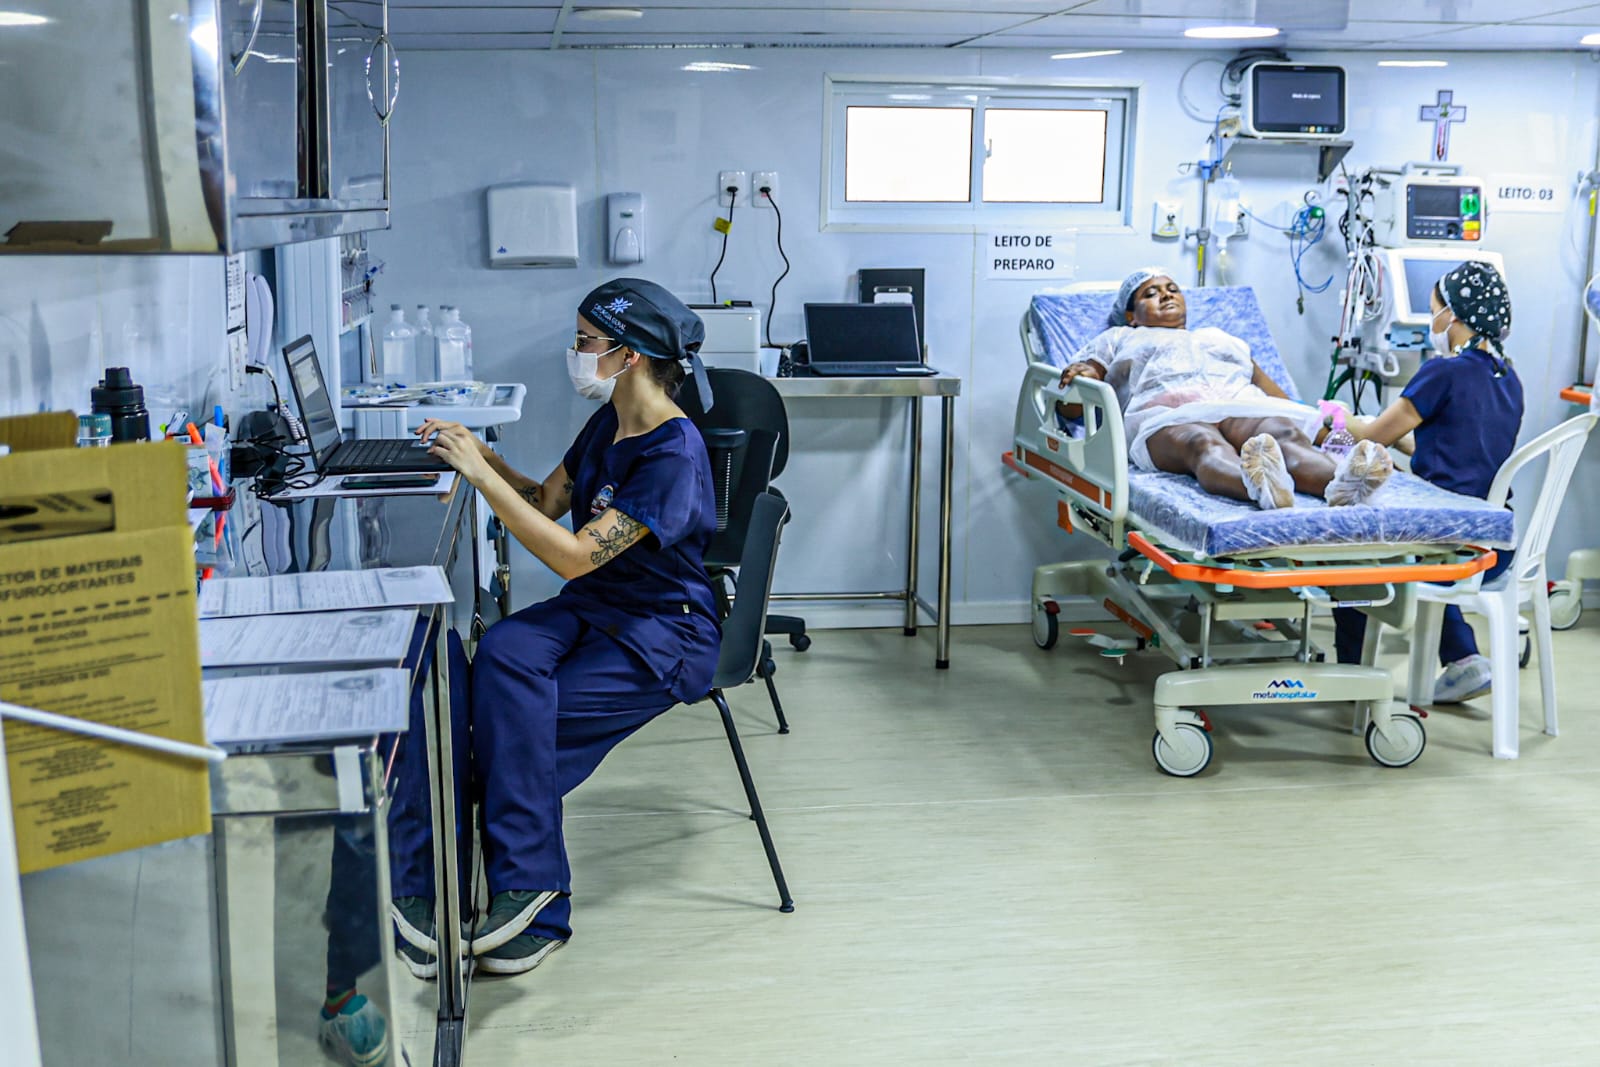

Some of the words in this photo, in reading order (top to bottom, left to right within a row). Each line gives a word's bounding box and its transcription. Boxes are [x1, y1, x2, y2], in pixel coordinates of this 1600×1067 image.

[1498, 187, 1535, 200] LEITO:
[1539, 188, 1553, 201] 03
[994, 235, 1031, 248] LEITO
[1035, 235, 1053, 248] DE
[993, 258, 1055, 271] PREPARO
[40, 566, 61, 581] DE
[65, 555, 143, 577] MATERIAIS
